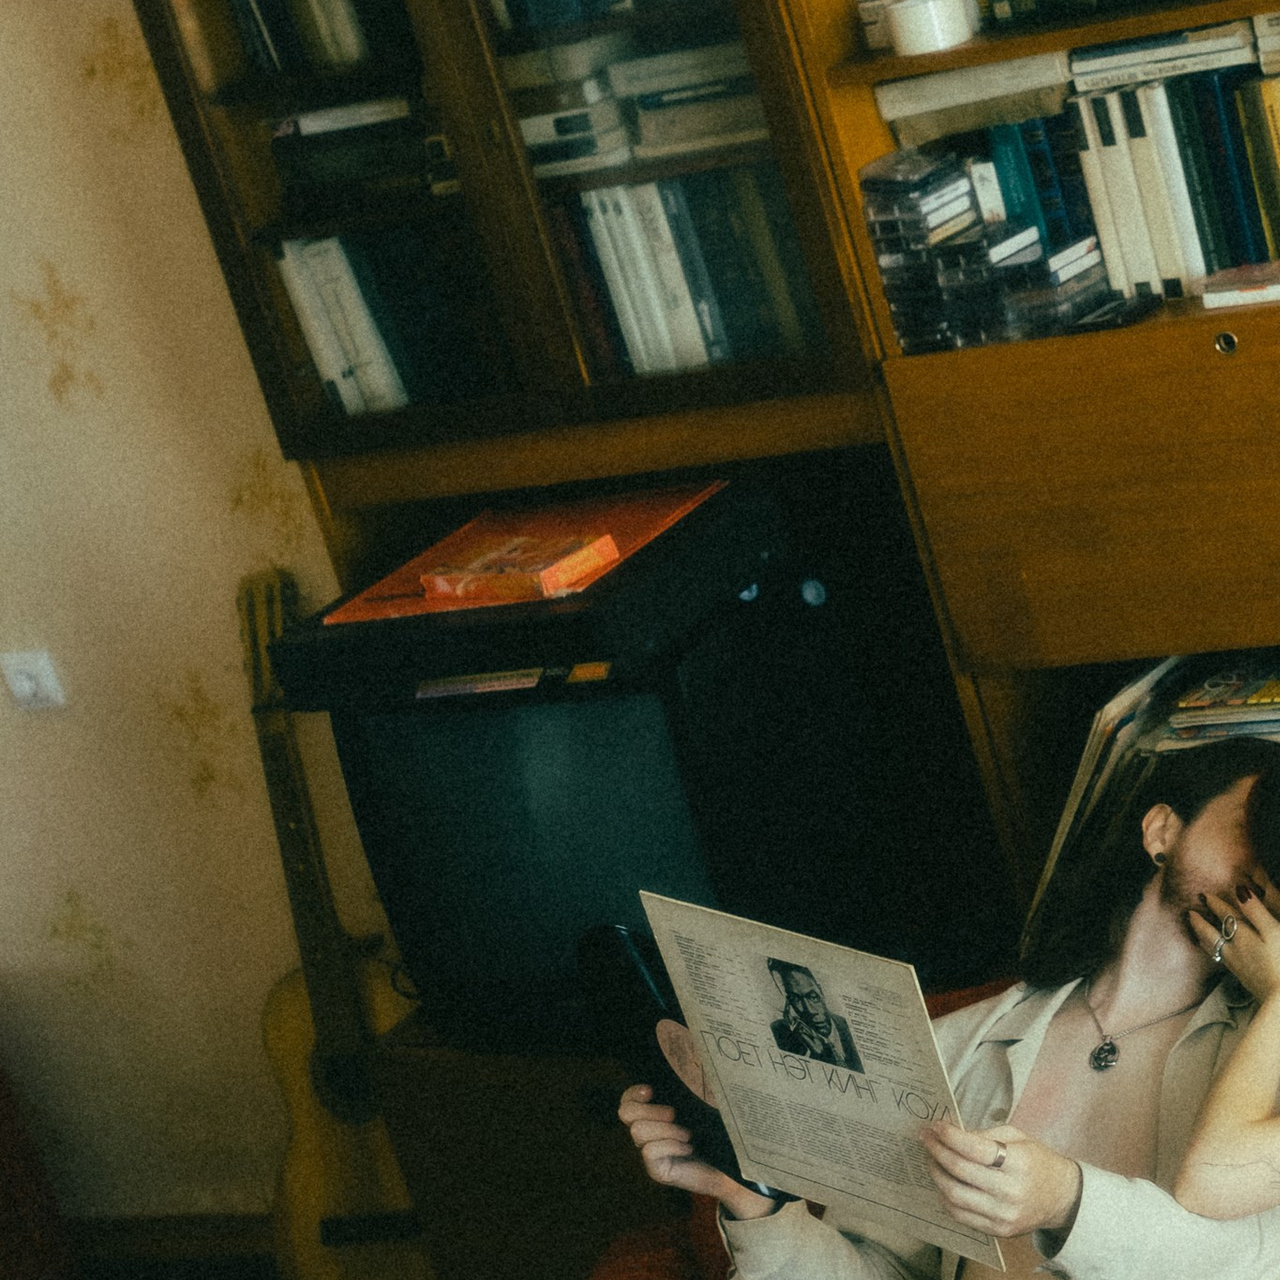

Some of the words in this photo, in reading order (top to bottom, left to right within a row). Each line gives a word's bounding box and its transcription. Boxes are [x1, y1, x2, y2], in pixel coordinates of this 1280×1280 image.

[701, 1030, 762, 1072] ПОЕТ
[766, 1045, 815, 1082] НЭТ
[822, 1066, 881, 1105] КИНГ
